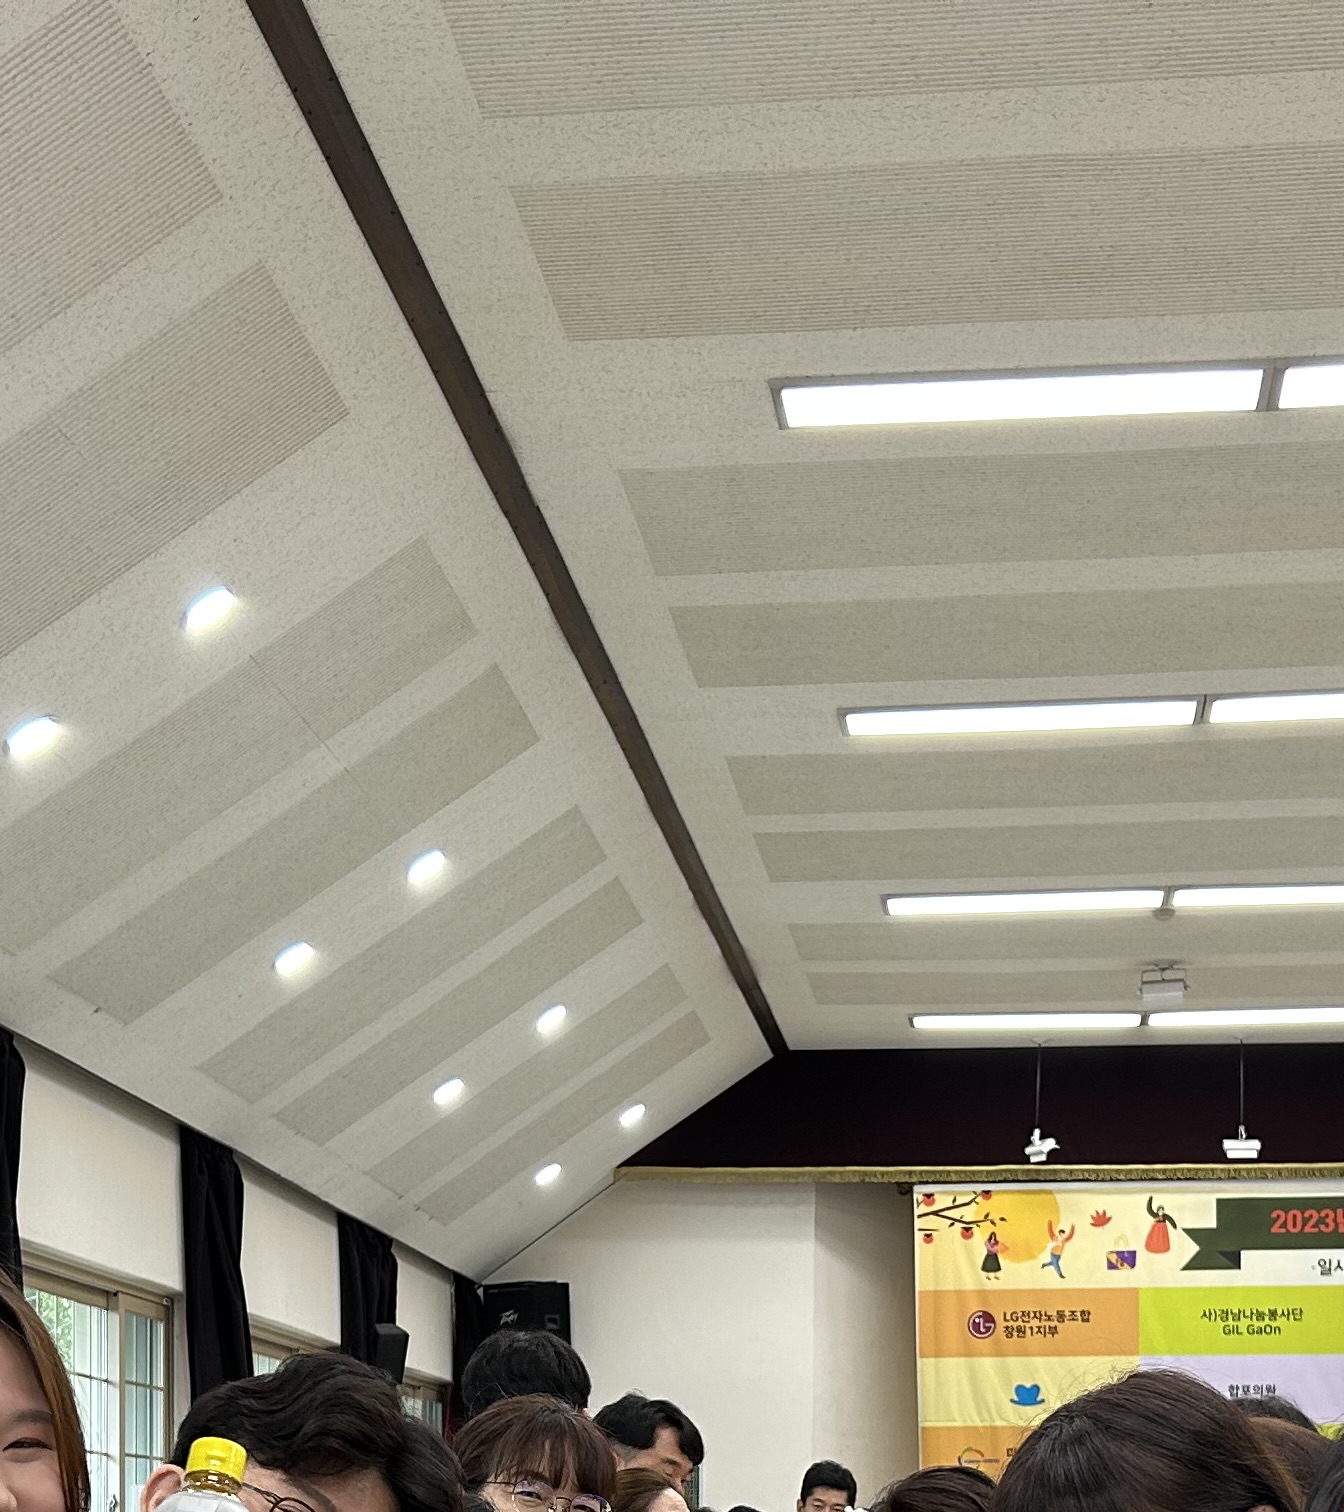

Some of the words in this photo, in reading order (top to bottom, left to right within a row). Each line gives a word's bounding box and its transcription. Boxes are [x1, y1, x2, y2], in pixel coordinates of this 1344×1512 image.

[1003, 1309, 1092, 1325] LG전자노동조합
[1003, 1324, 1059, 1339] 창원1지부
[1246, 1323, 1282, 1337] GaOn
